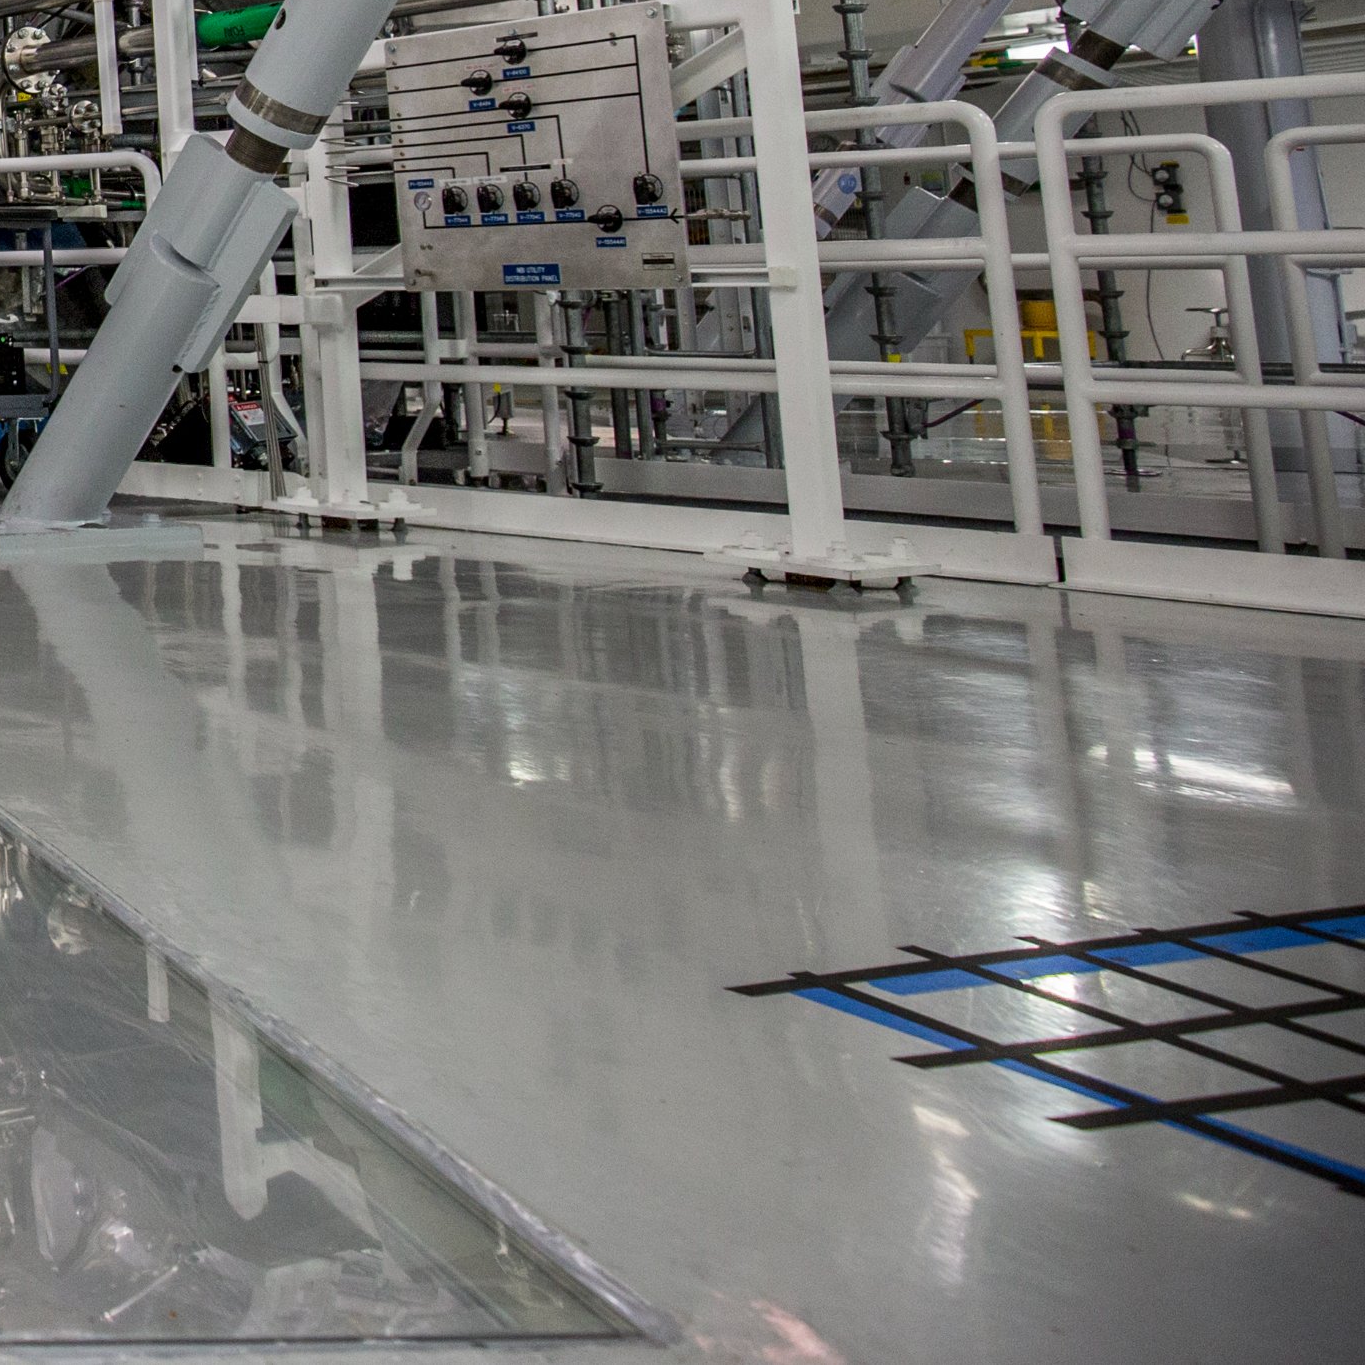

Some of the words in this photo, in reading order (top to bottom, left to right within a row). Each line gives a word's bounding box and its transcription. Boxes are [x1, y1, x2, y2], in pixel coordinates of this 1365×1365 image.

[526, 266, 546, 274] UTILITY
[505, 274, 540, 282] DISTRIBUTION
[541, 274, 559, 282] PANEL
